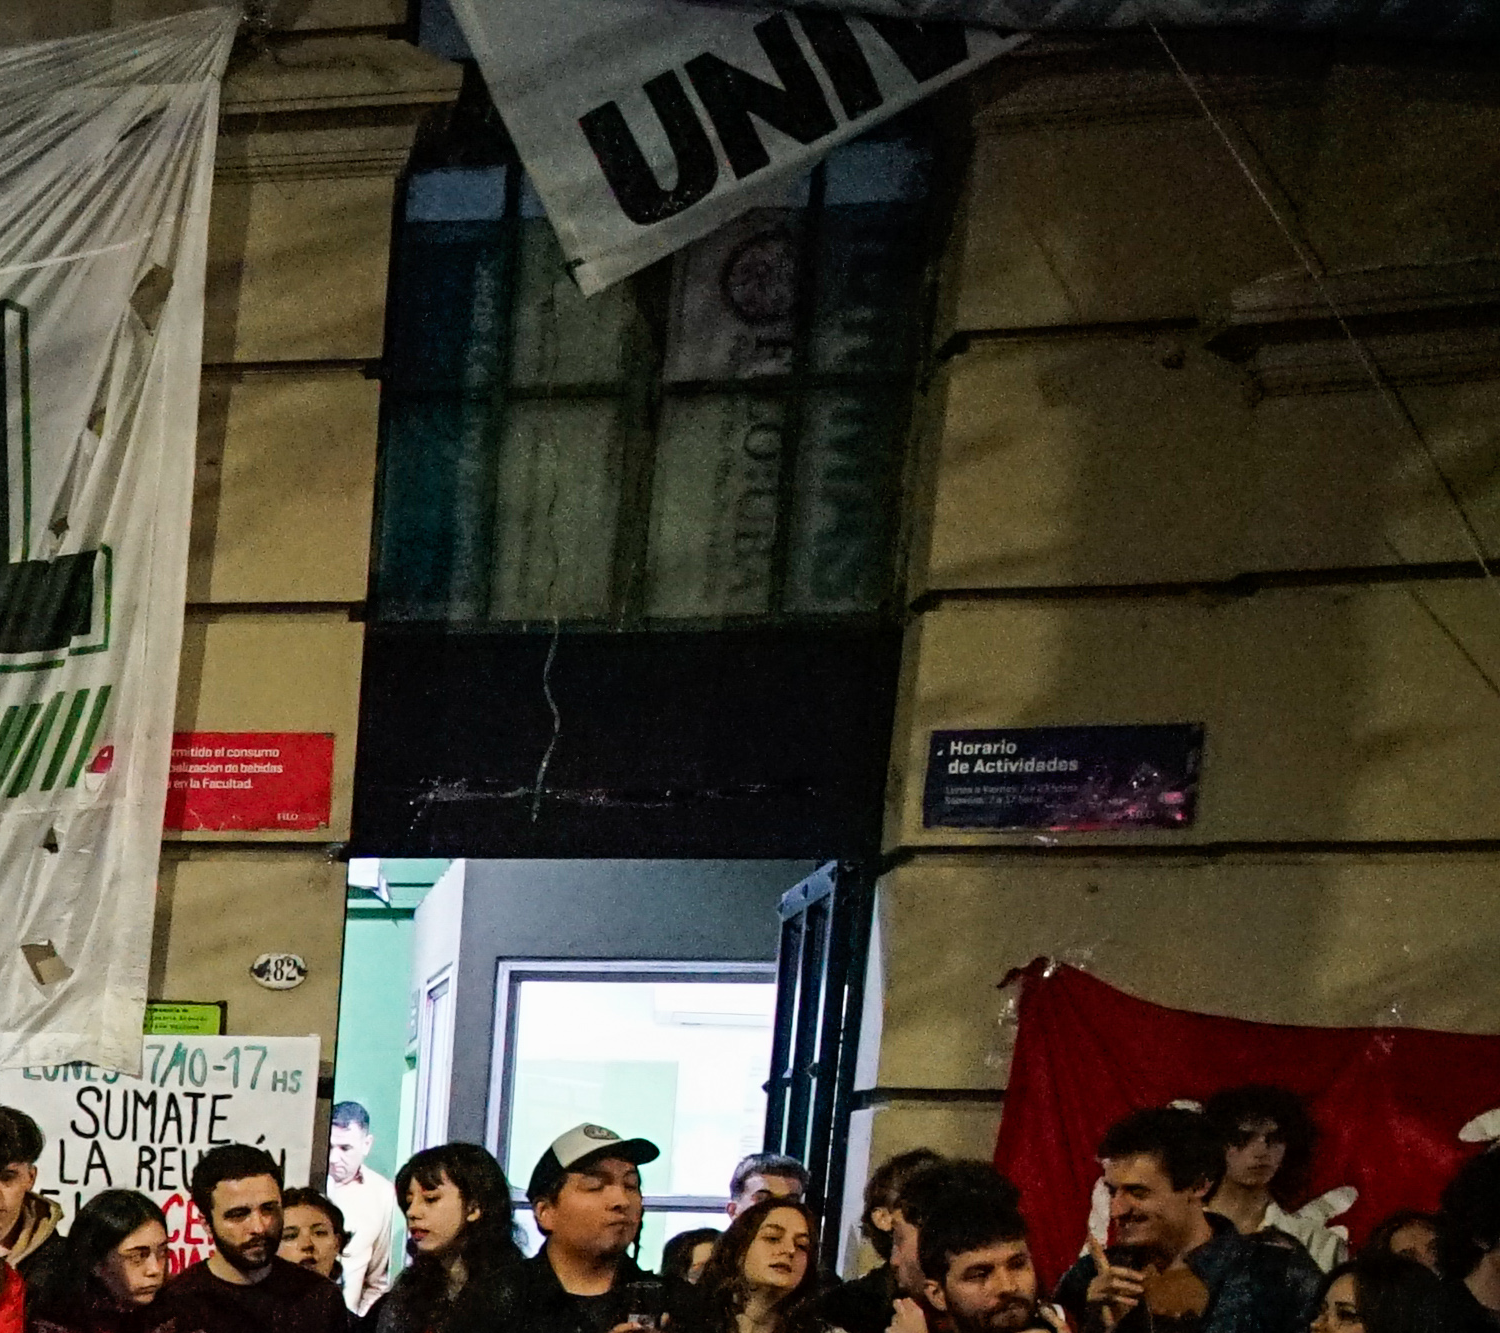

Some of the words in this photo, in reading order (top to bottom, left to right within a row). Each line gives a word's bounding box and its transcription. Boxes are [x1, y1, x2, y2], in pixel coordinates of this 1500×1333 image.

[215, 747, 224, 758] el
[227, 749, 280, 758] consumo
[949, 739, 1018, 756] Horario
[240, 762, 283, 774] bebidas
[948, 759, 969, 774] de
[974, 757, 1079, 774] Actividades
[190, 779, 200, 789] la
[202, 778, 254, 789] Facultad.
[271, 1069, 302, 1094] HS
[70, 1085, 233, 1145] SUMATE
[59, 1138, 113, 1187] LA
